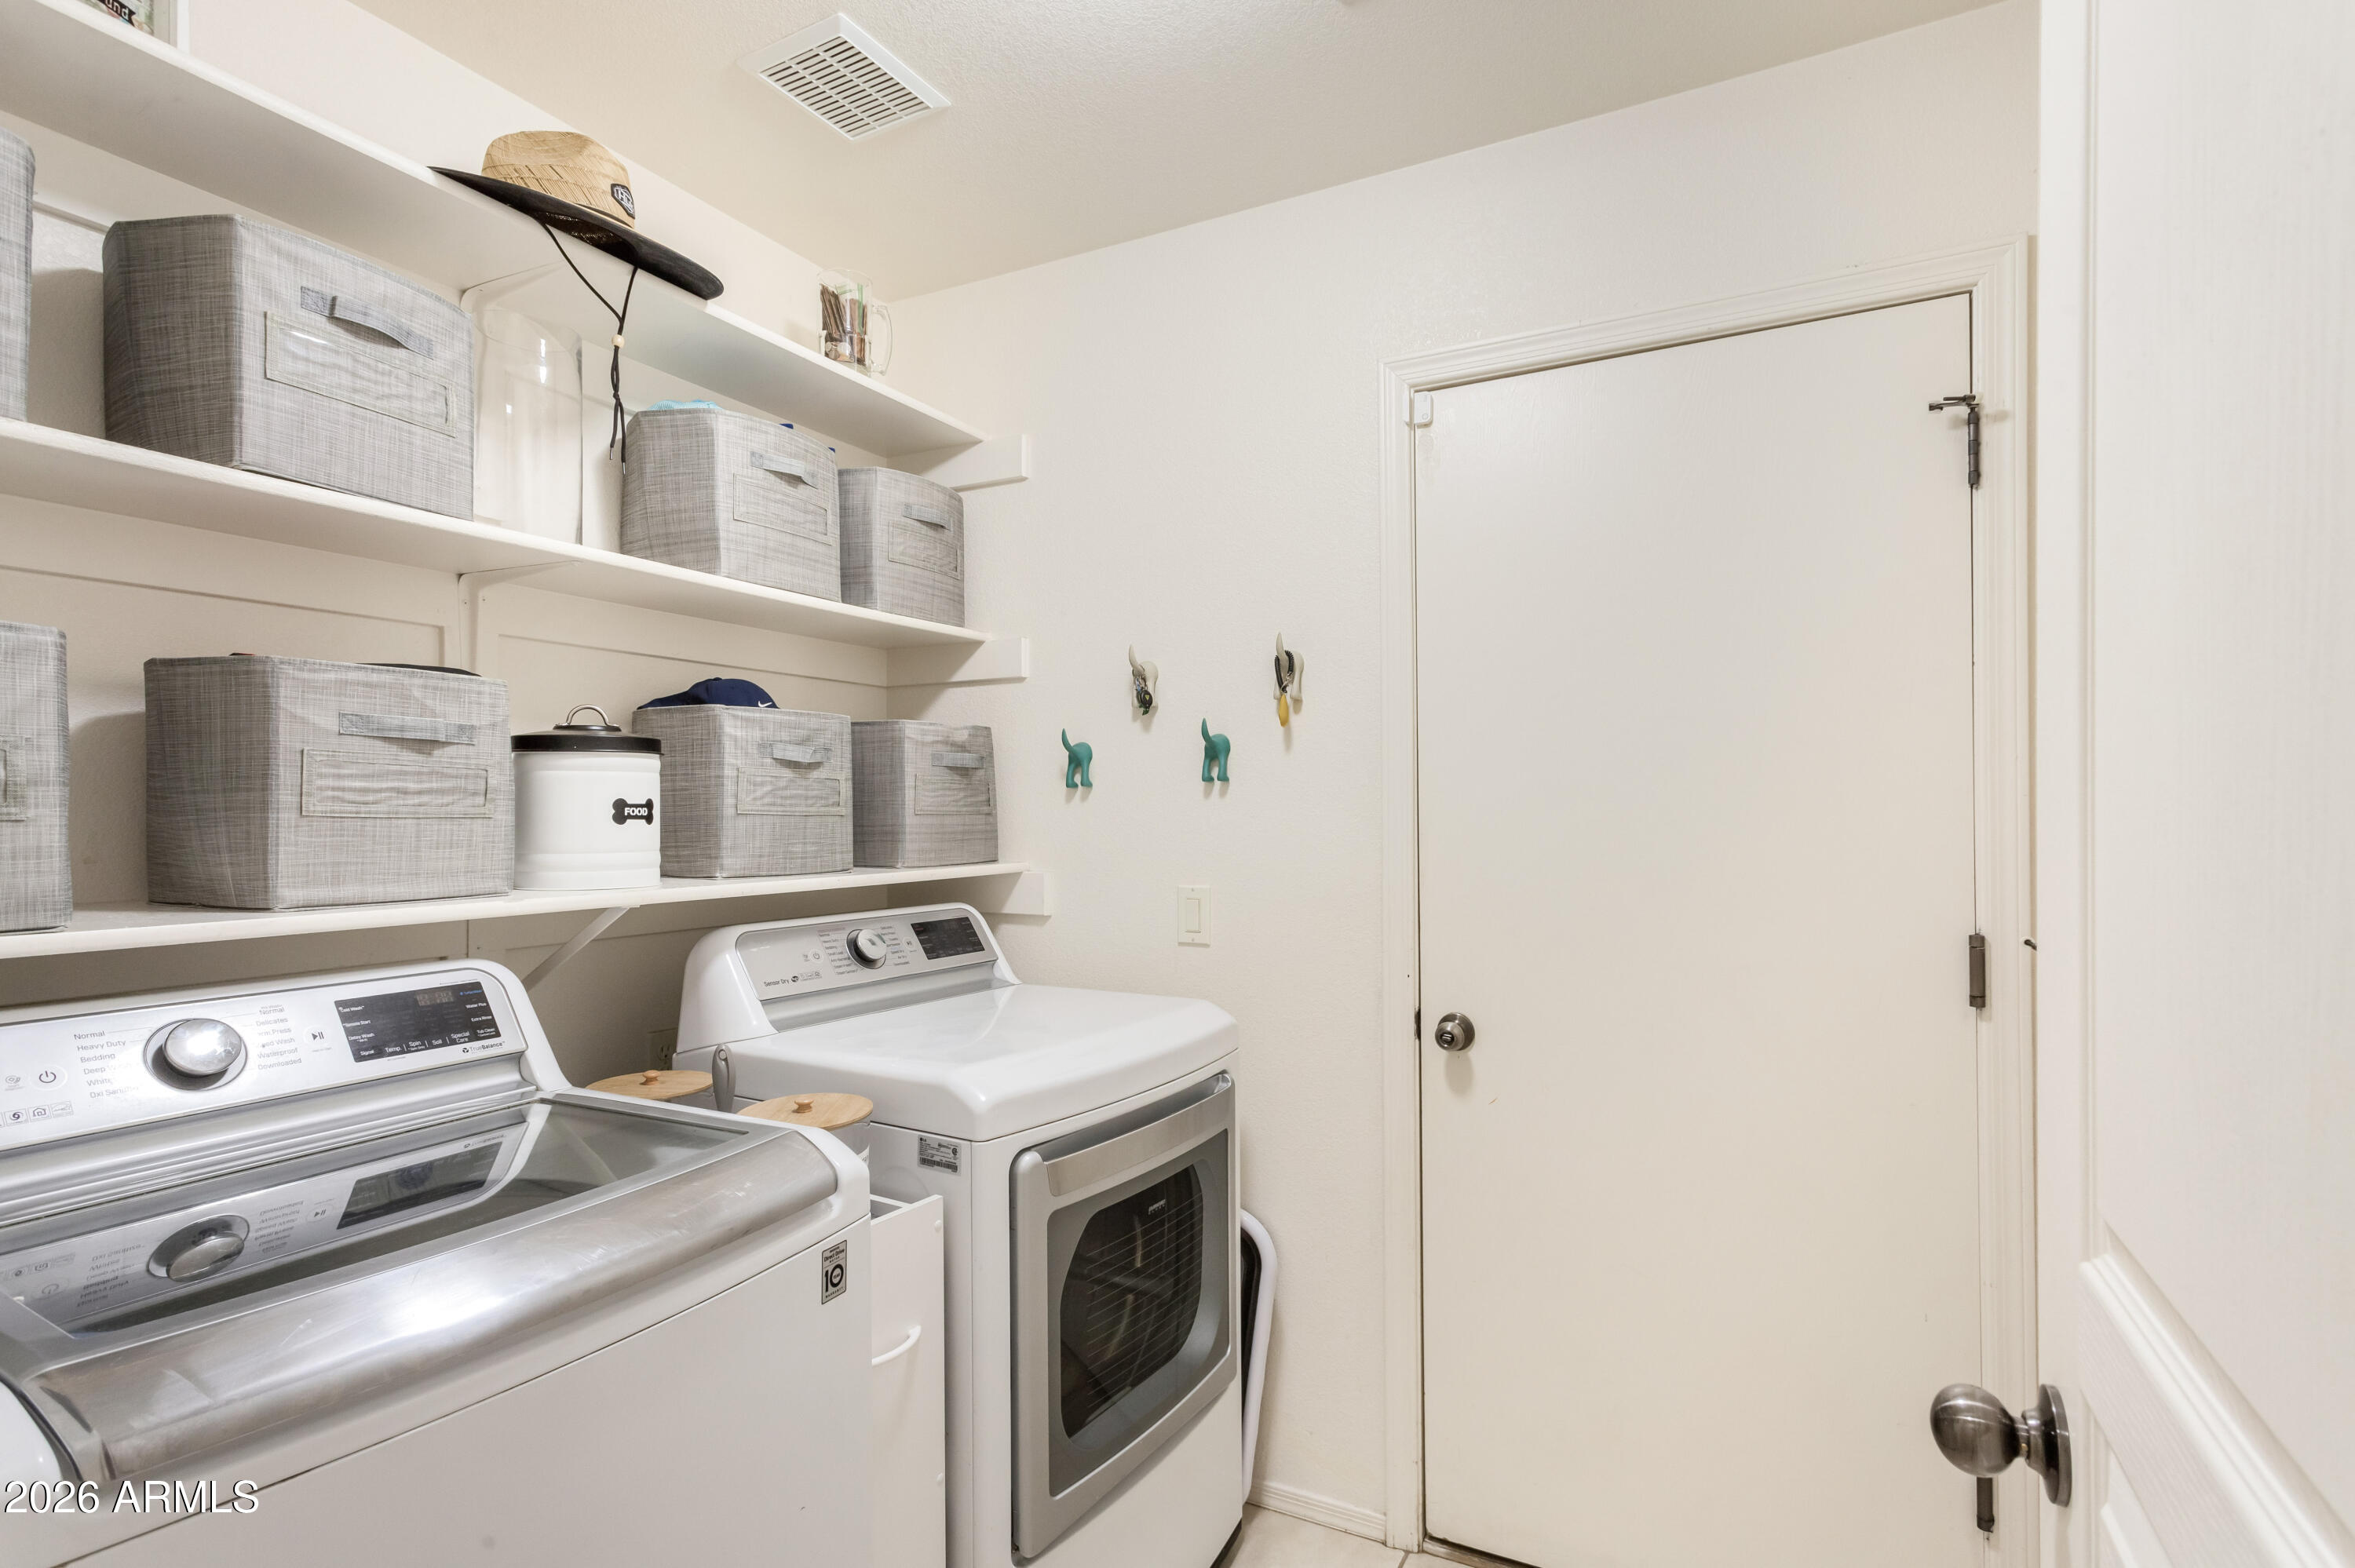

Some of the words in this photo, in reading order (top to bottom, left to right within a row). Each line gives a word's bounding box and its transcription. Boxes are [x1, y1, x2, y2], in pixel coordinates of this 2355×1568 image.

[624, 807, 648, 816] FOOD
[259, 1007, 285, 1016] Normal
[256, 1017, 289, 1026] Delicates
[74, 1030, 105, 1040] Normal
[276, 1037, 295, 1045] Wash
[77, 1043, 104, 1052] Heavy
[80, 1053, 115, 1063] Bedding
[257, 1048, 298, 1059] Waterproof
[257, 1058, 302, 1070] Downloaded
[83, 1067, 106, 1075] Deep
[824, 1253, 834, 1262] Direct
[825, 1264, 844, 1293] 10
